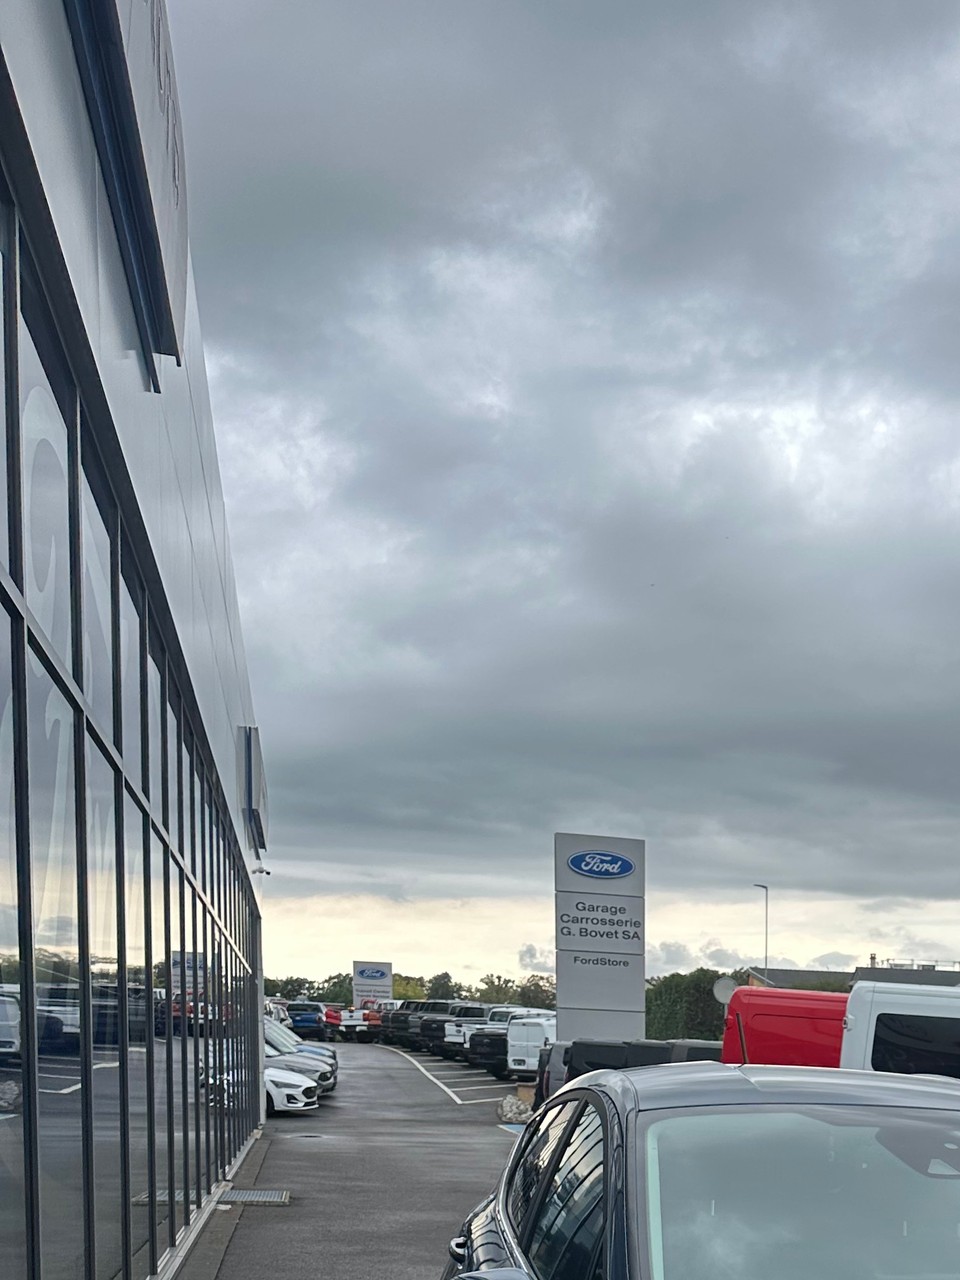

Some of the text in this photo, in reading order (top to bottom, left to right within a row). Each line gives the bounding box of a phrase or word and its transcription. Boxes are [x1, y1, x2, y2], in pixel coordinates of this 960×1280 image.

[581, 854, 622, 873] Ford
[575, 902, 626, 915] Garage
[560, 914, 641, 928] Carrosserie
[561, 927, 641, 940] G. Bovet SA
[574, 956, 629, 967] FordStore
